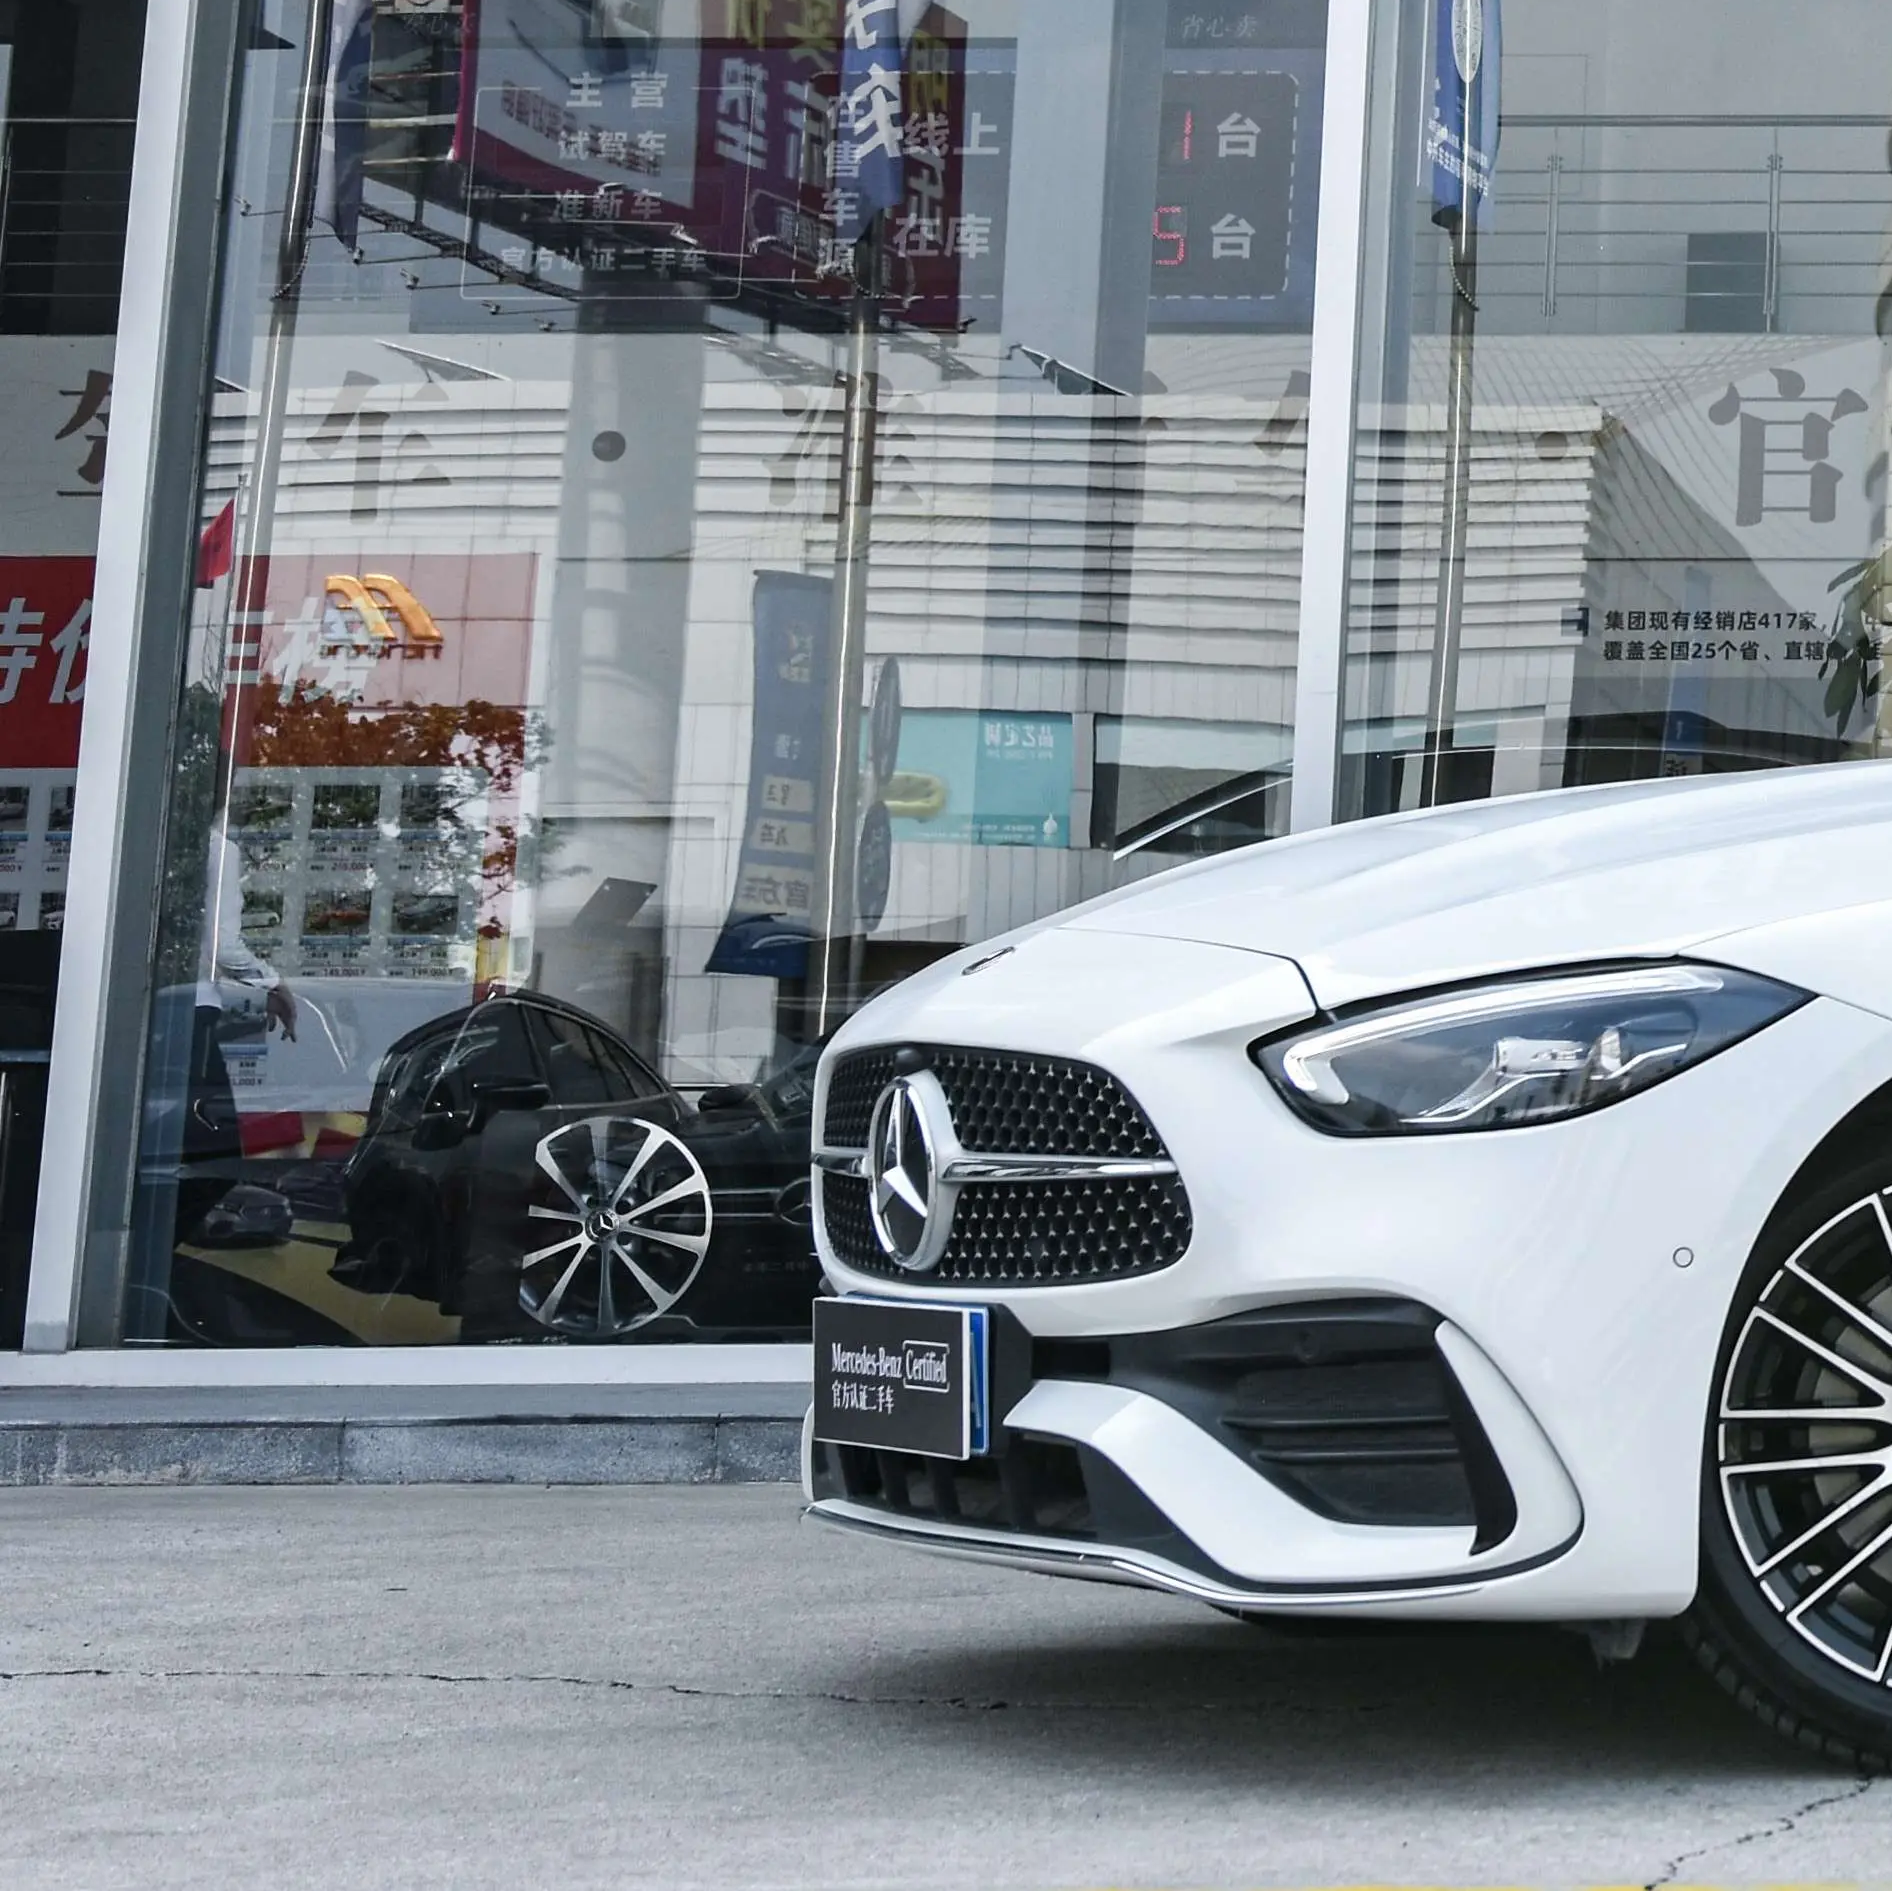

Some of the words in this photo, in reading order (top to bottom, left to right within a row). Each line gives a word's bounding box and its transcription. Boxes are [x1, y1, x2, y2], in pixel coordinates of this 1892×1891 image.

[565, 71, 669, 109] 主营
[557, 130, 668, 162] 试驾车
[903, 111, 1001, 157] 线上
[1216, 111, 1262, 158] 台
[554, 188, 664, 221] 准新车
[892, 213, 993, 259] 在库
[1152, 205, 1186, 265] 5
[1210, 212, 1257, 260] 台
[499, 246, 709, 274] 官方认证二手车
[831, 1342, 903, 1379] Mercedes-Benz
[905, 1349, 947, 1383] Certified
[831, 1379, 895, 1415] 官方认证二手车
